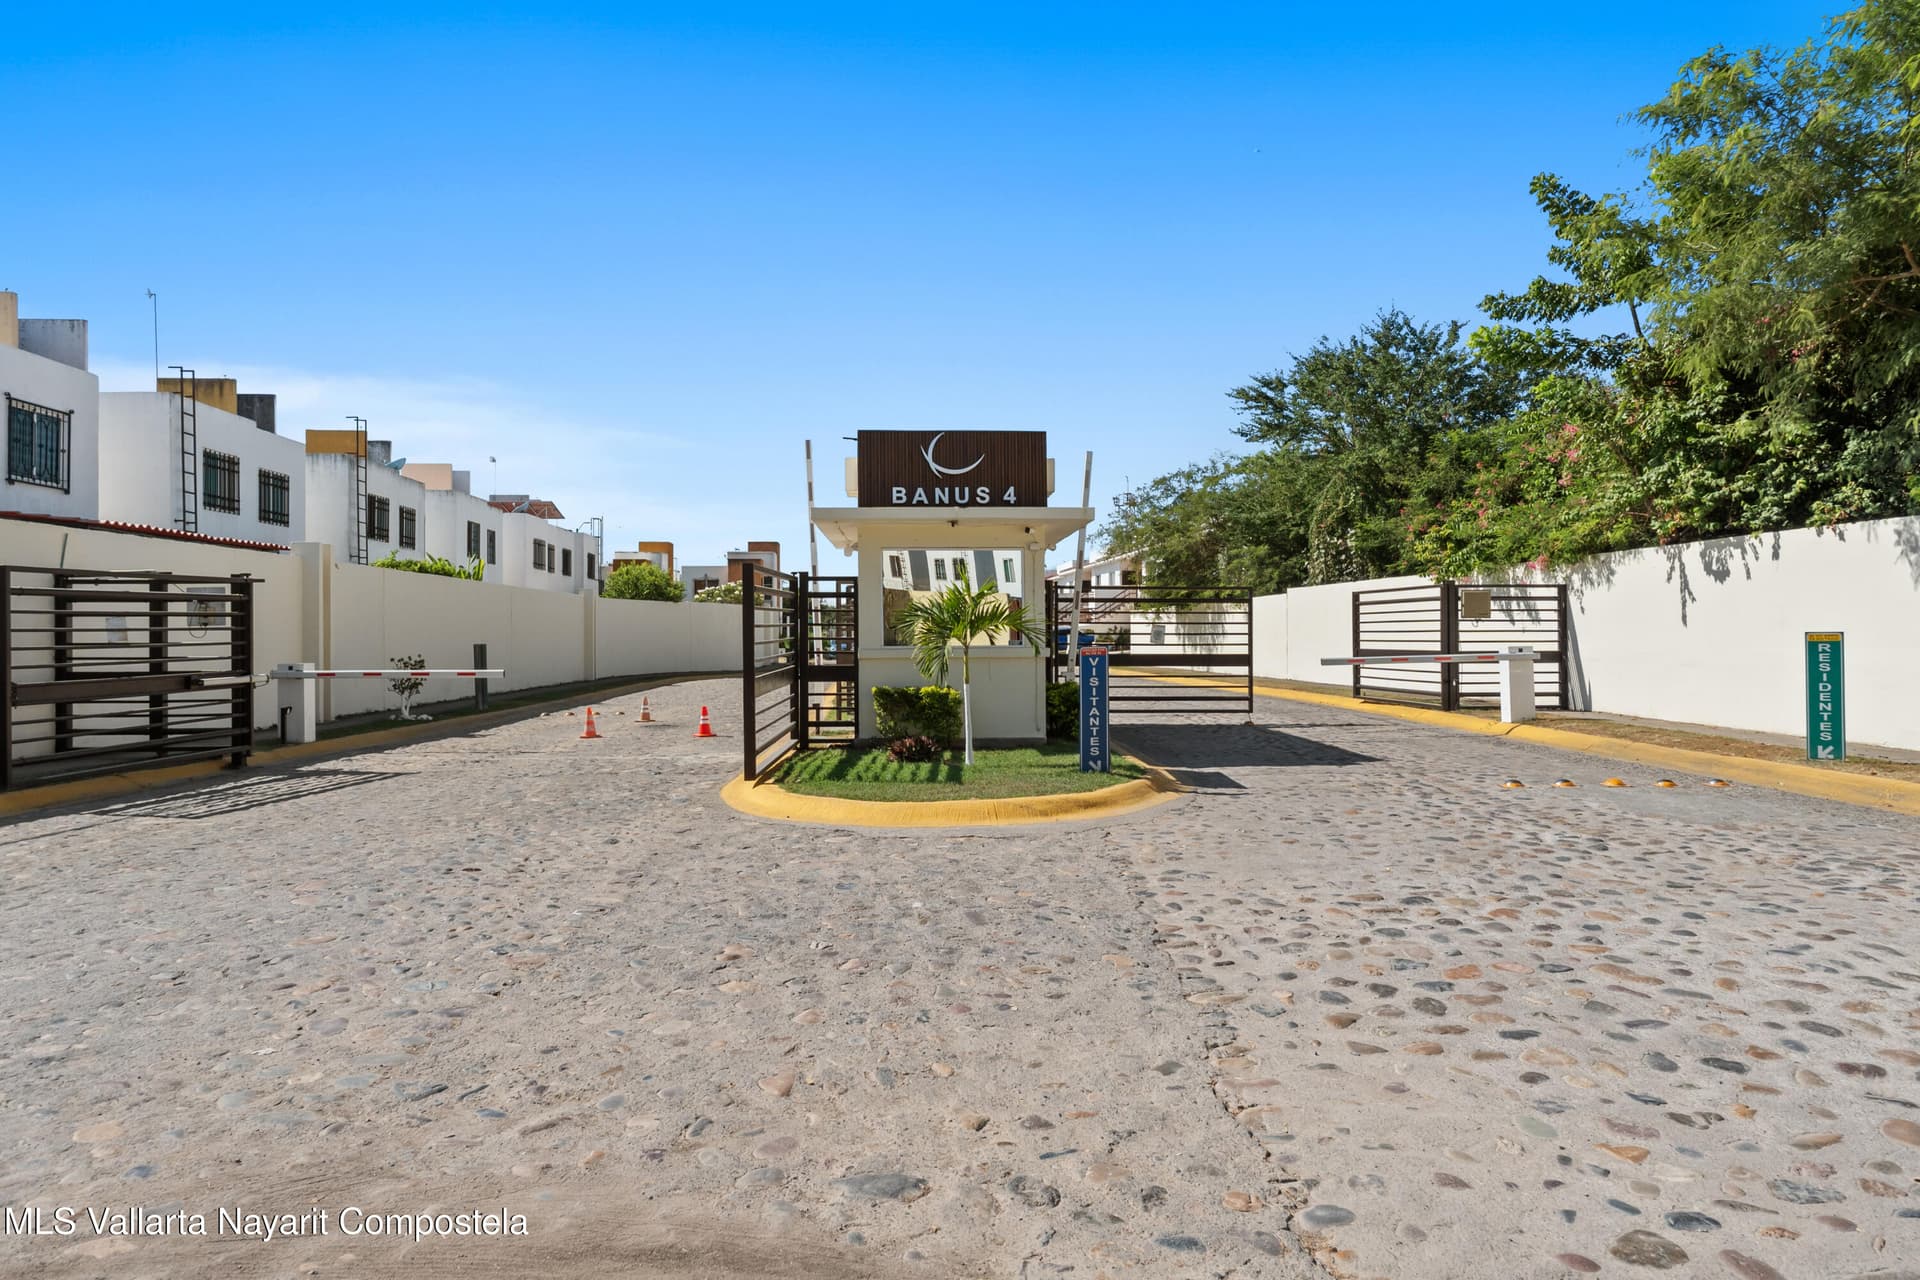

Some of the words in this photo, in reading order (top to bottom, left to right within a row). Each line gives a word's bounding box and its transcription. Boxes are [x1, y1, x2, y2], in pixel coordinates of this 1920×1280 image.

[892, 486, 991, 504] BANUS
[1003, 486, 1017, 504] 4
[1088, 657, 1100, 756] VISITANTES
[1817, 643, 1833, 741] RESIDENTES
